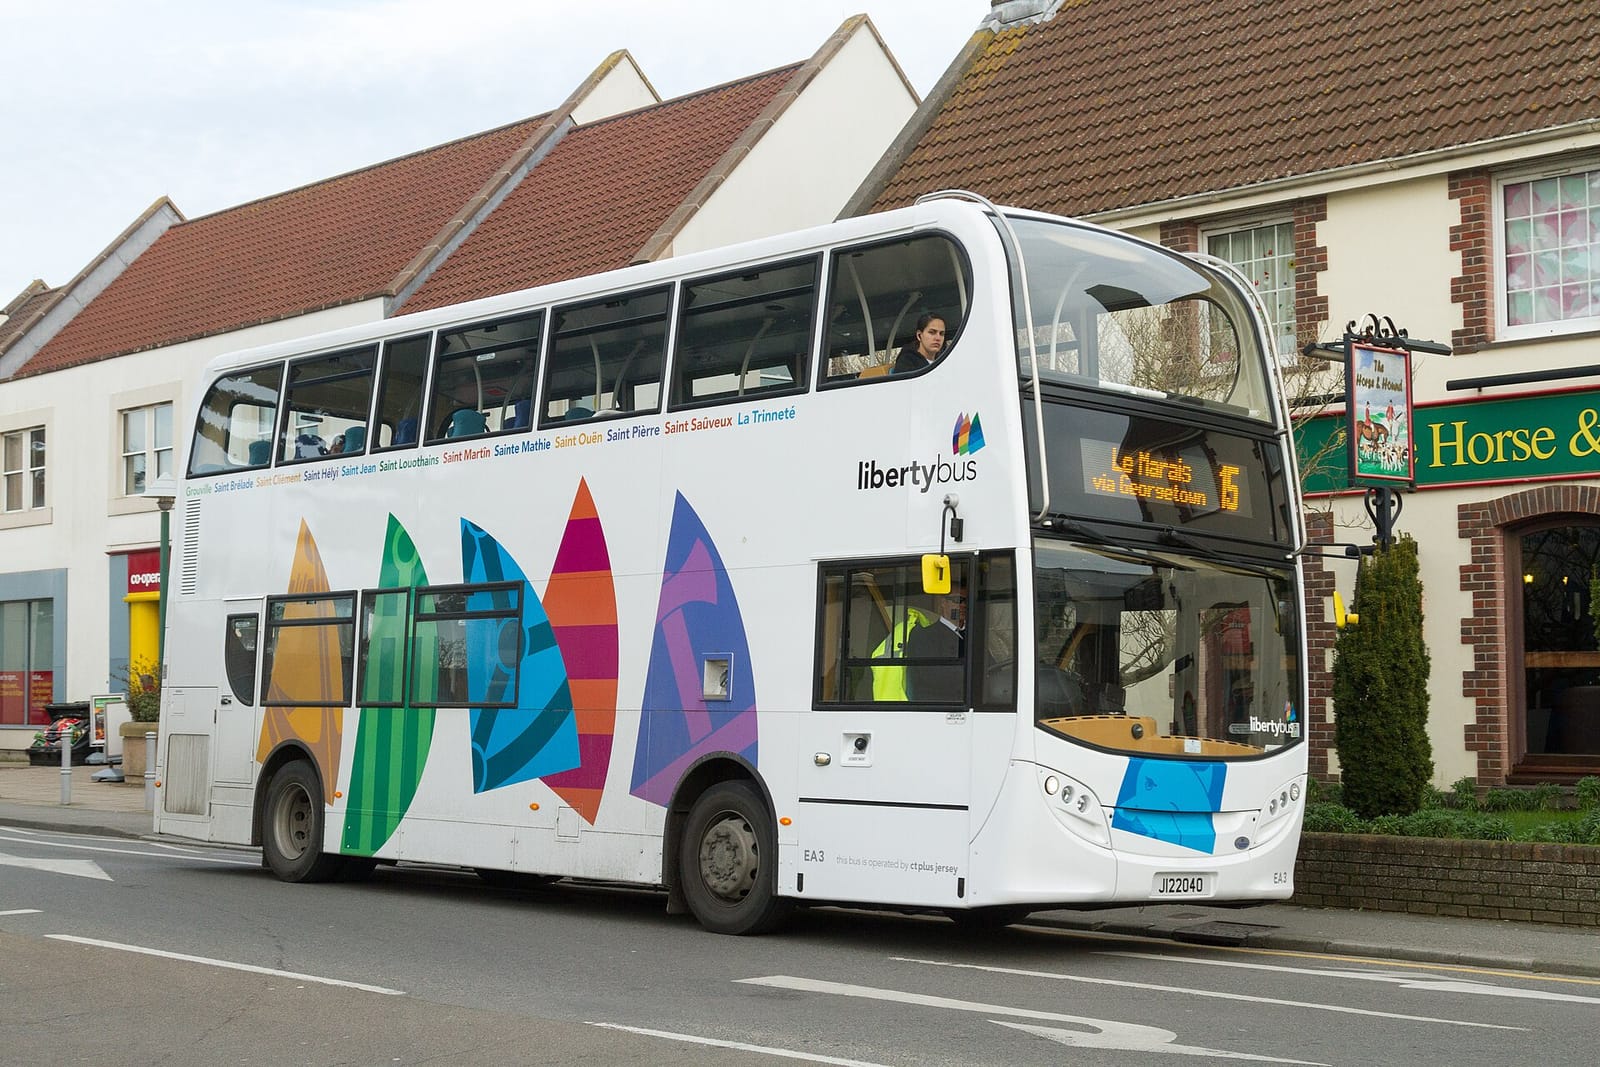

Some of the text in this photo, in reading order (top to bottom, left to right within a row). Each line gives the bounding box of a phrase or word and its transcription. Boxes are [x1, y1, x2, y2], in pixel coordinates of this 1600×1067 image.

[1376, 376, 1380, 389] &
[214, 482, 229, 493] Saint
[256, 476, 272, 487] Saint
[304, 470, 320, 481] Saint
[342, 465, 358, 476] Saint
[359, 464, 376, 474] Jean
[379, 459, 397, 471] Saint
[443, 450, 462, 463] Saint
[494, 444, 519, 456] Sainte
[521, 438, 551, 453] Mathie
[555, 434, 576, 448] Saint
[578, 432, 603, 445] Ouën
[607, 428, 630, 442] Saint
[632, 425, 660, 438] Pièrre
[665, 420, 689, 434] Saint
[691, 416, 733, 431] Saûveux
[737, 412, 750, 425] La
[752, 405, 796, 423] Trinneté
[1428, 421, 1557, 468] Horse
[1569, 408, 1600, 457] &
[857, 453, 977, 494] libertybus
[1111, 447, 1192, 483] Le Marais
[1091, 473, 1207, 506] via Georgetown
[1218, 465, 1240, 512] 15
[804, 850, 825, 862] EA3
[836, 854, 848, 864] this
[848, 856, 860, 865] bus
[868, 858, 899, 869] operated
[900, 860, 909, 871] by
[918, 861, 934, 872] plus
[934, 862, 958, 875] jersey
[1273, 872, 1287, 884] EA3
